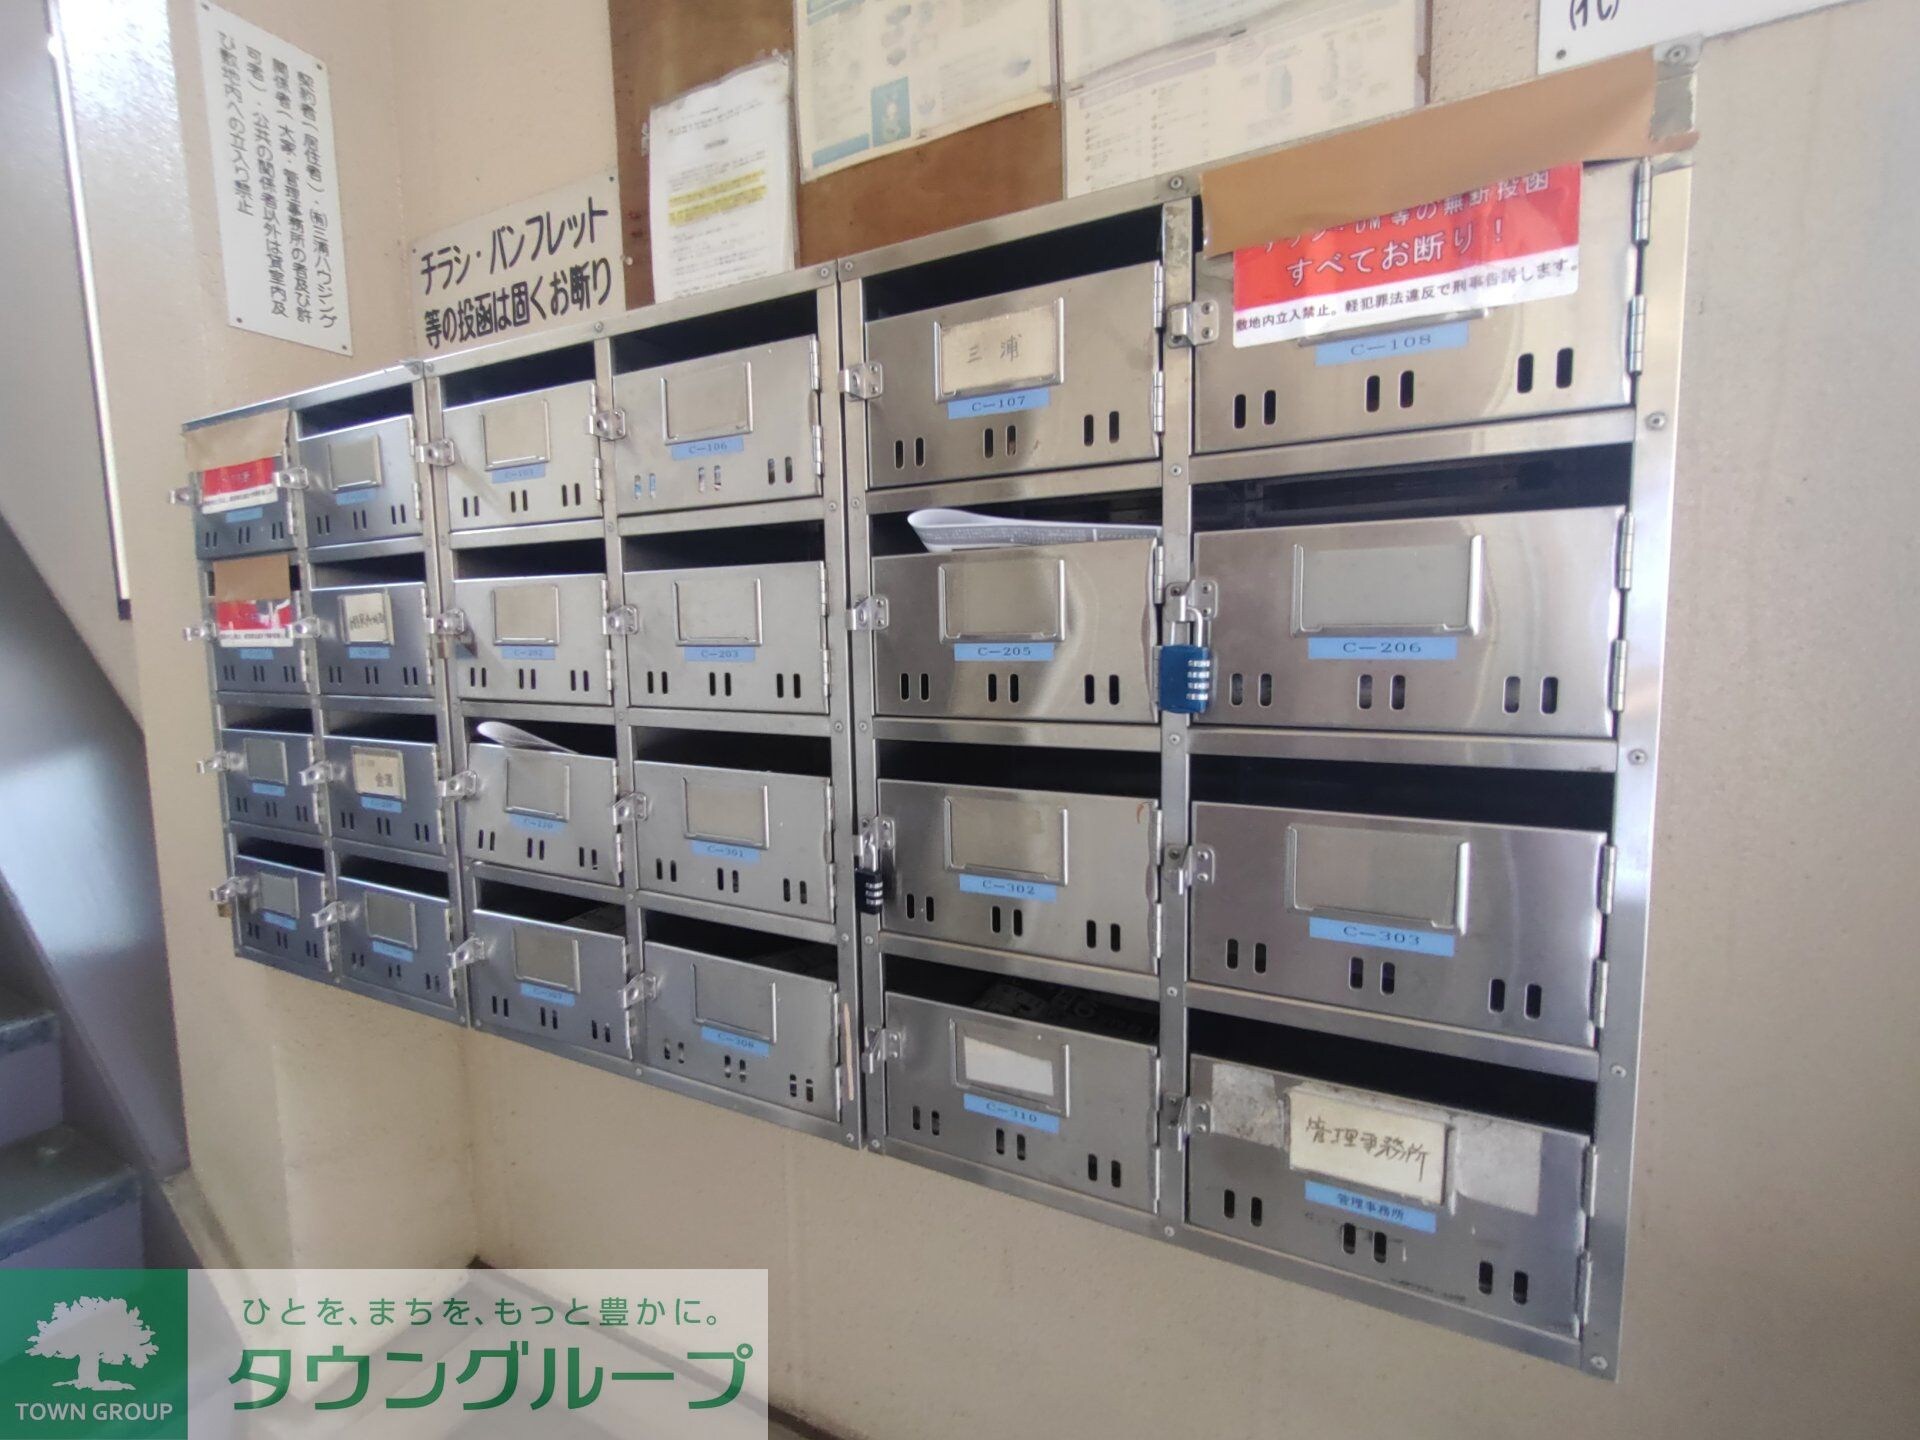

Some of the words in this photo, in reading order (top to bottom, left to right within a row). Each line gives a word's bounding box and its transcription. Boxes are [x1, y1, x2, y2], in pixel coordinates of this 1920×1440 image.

[421, 196, 609, 295] チラシ・パンフレット
[425, 257, 611, 350] 等の投函は固くお断り
[1305, 1116, 1429, 1182] 管理事務所
[1337, 1192, 1405, 1221] 管理事務所
